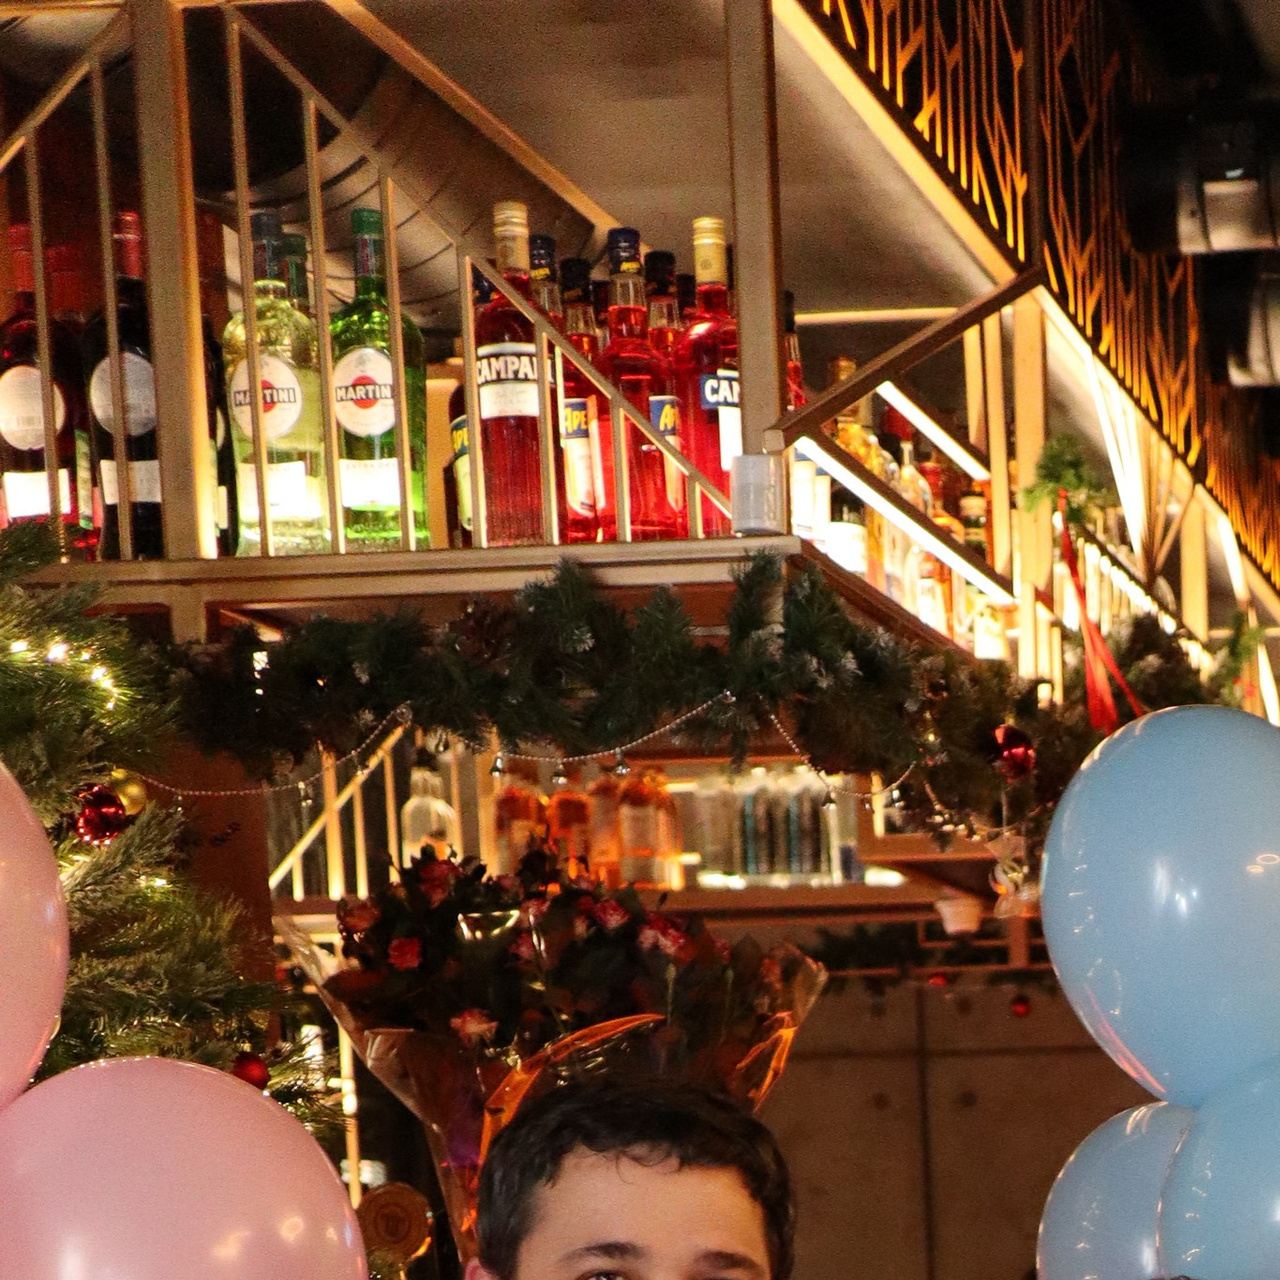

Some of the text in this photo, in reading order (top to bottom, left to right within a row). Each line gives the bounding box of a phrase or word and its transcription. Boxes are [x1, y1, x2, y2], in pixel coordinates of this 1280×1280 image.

[477, 355, 554, 384] CAMPAI
[234, 388, 296, 405] MATINI
[336, 385, 392, 401] MARTIN
